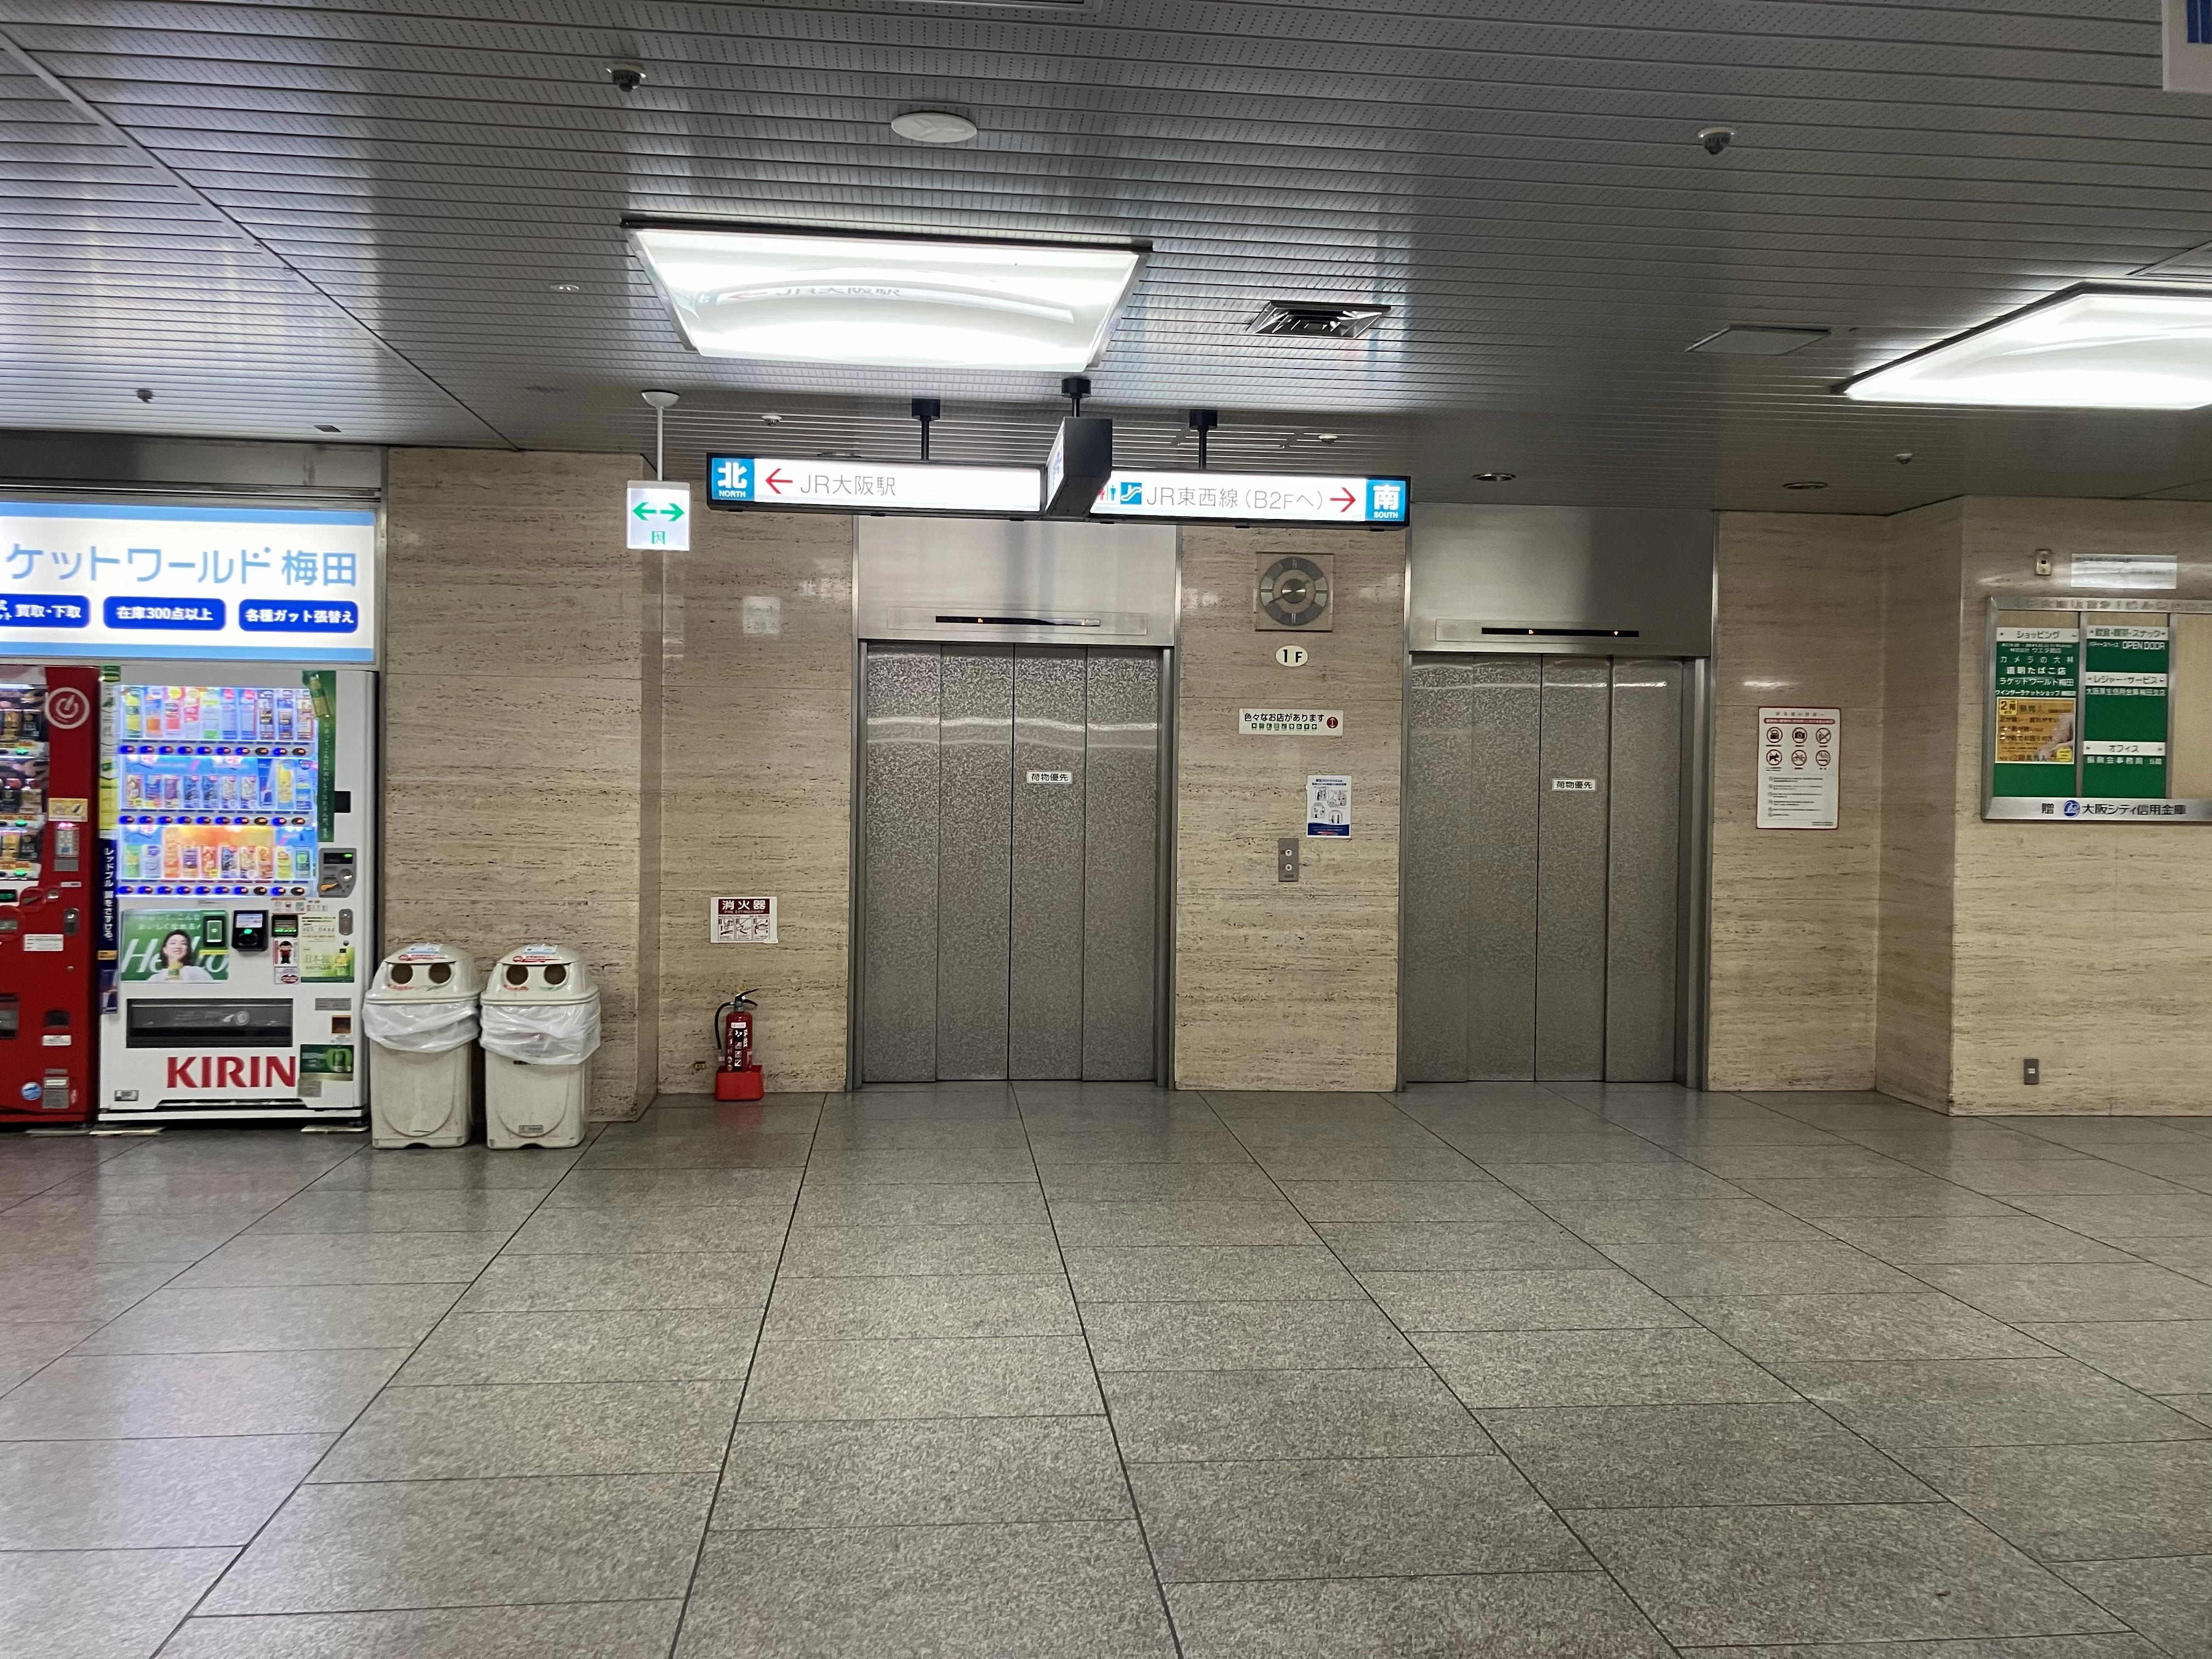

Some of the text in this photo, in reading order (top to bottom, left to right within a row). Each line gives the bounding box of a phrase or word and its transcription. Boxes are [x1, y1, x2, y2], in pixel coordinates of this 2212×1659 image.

[718, 462, 747, 489] 北
[800, 475, 895, 496] JR大阪駅
[719, 489, 746, 498] NORTH
[1373, 484, 1400, 510] 南
[116, 606, 213, 620] 在庫300点以上
[245, 608, 354, 624] 各種ガット張替え
[2017, 631, 2059, 639] ショッピング
[2143, 642, 2165, 650] DOOR
[1244, 713, 1324, 722] 色々なお店があります
[2081, 804, 2186, 815] 大阪シティ信用金庫
[723, 900, 766, 910] 消火器
[167, 1056, 296, 1088] KIRIN
